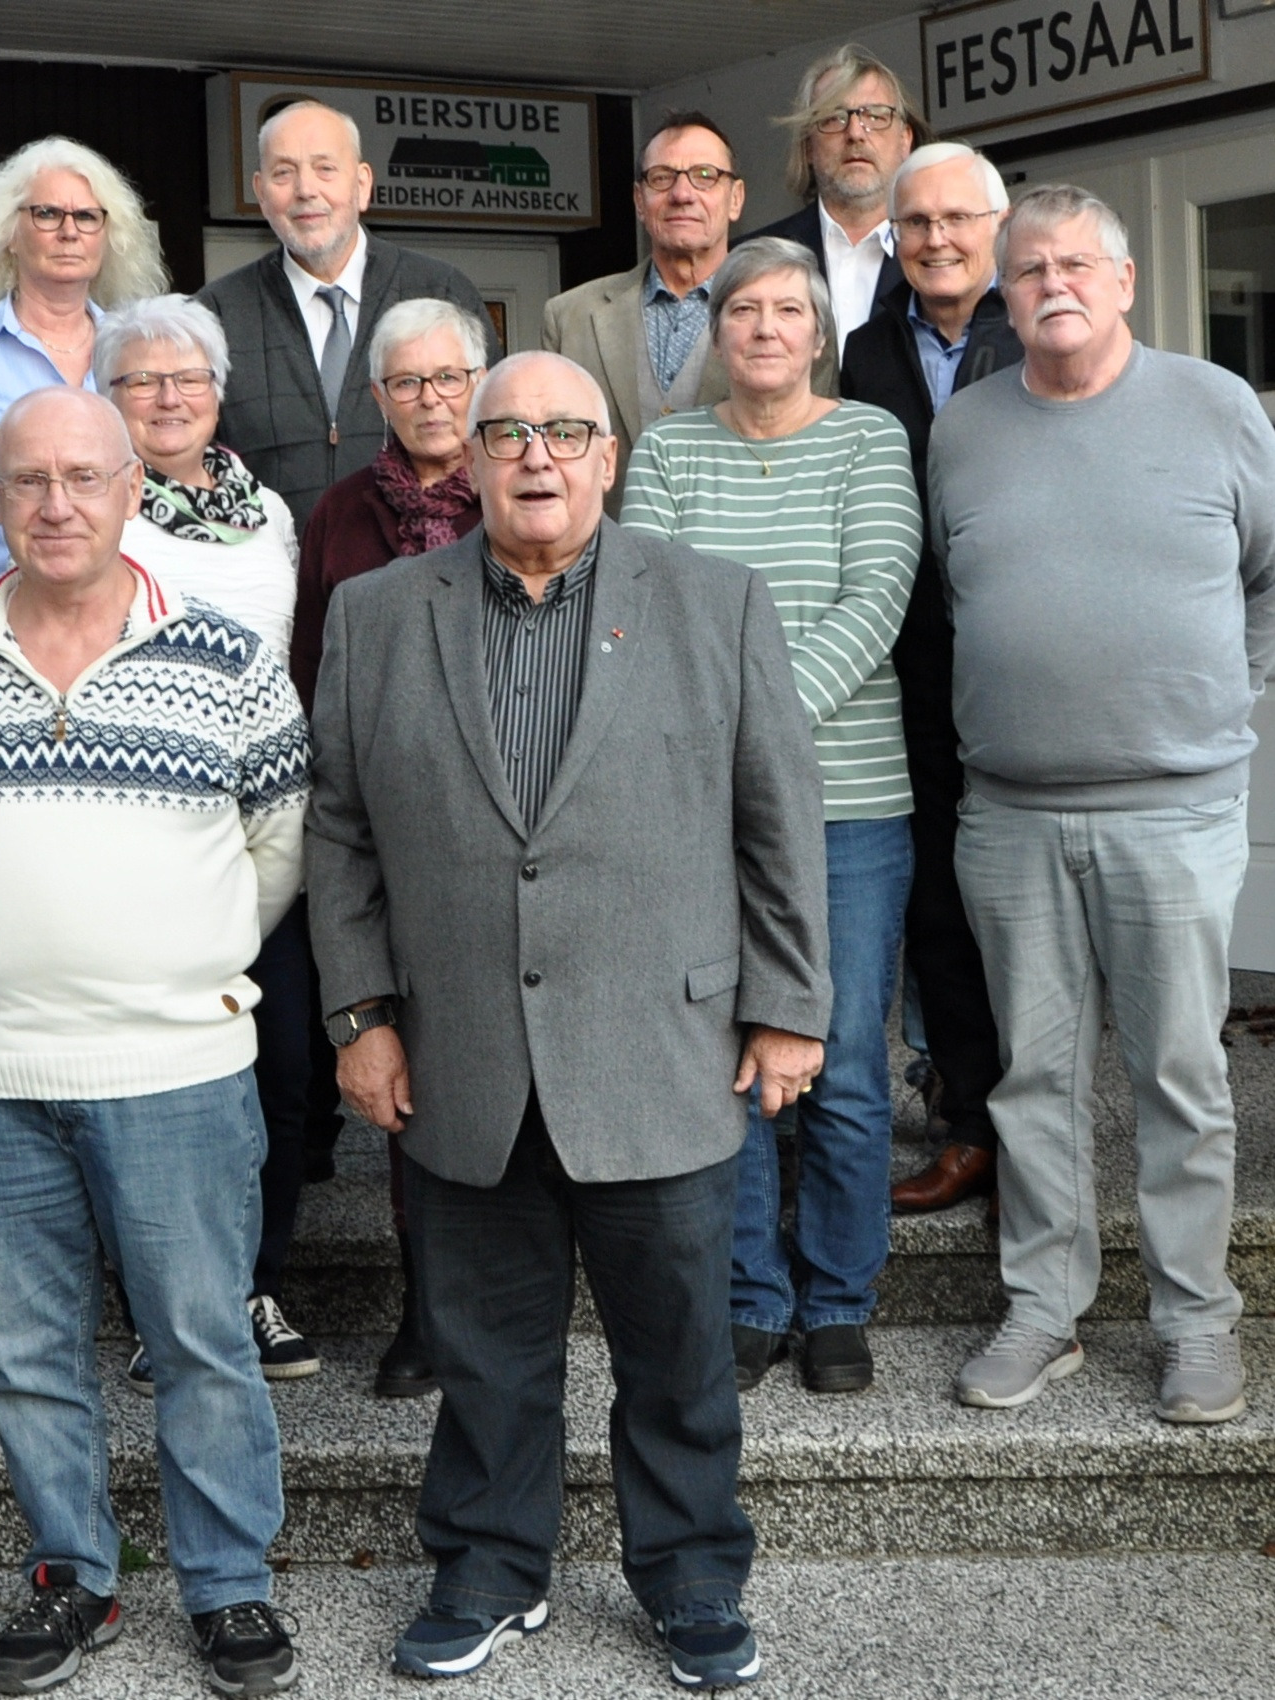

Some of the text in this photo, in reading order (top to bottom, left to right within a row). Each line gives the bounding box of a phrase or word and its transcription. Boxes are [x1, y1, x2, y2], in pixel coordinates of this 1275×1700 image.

[935, 0, 1194, 109] FESTSAAL
[374, 95, 561, 134] BIERSTUBE
[472, 188, 580, 212] AHNSBECK
